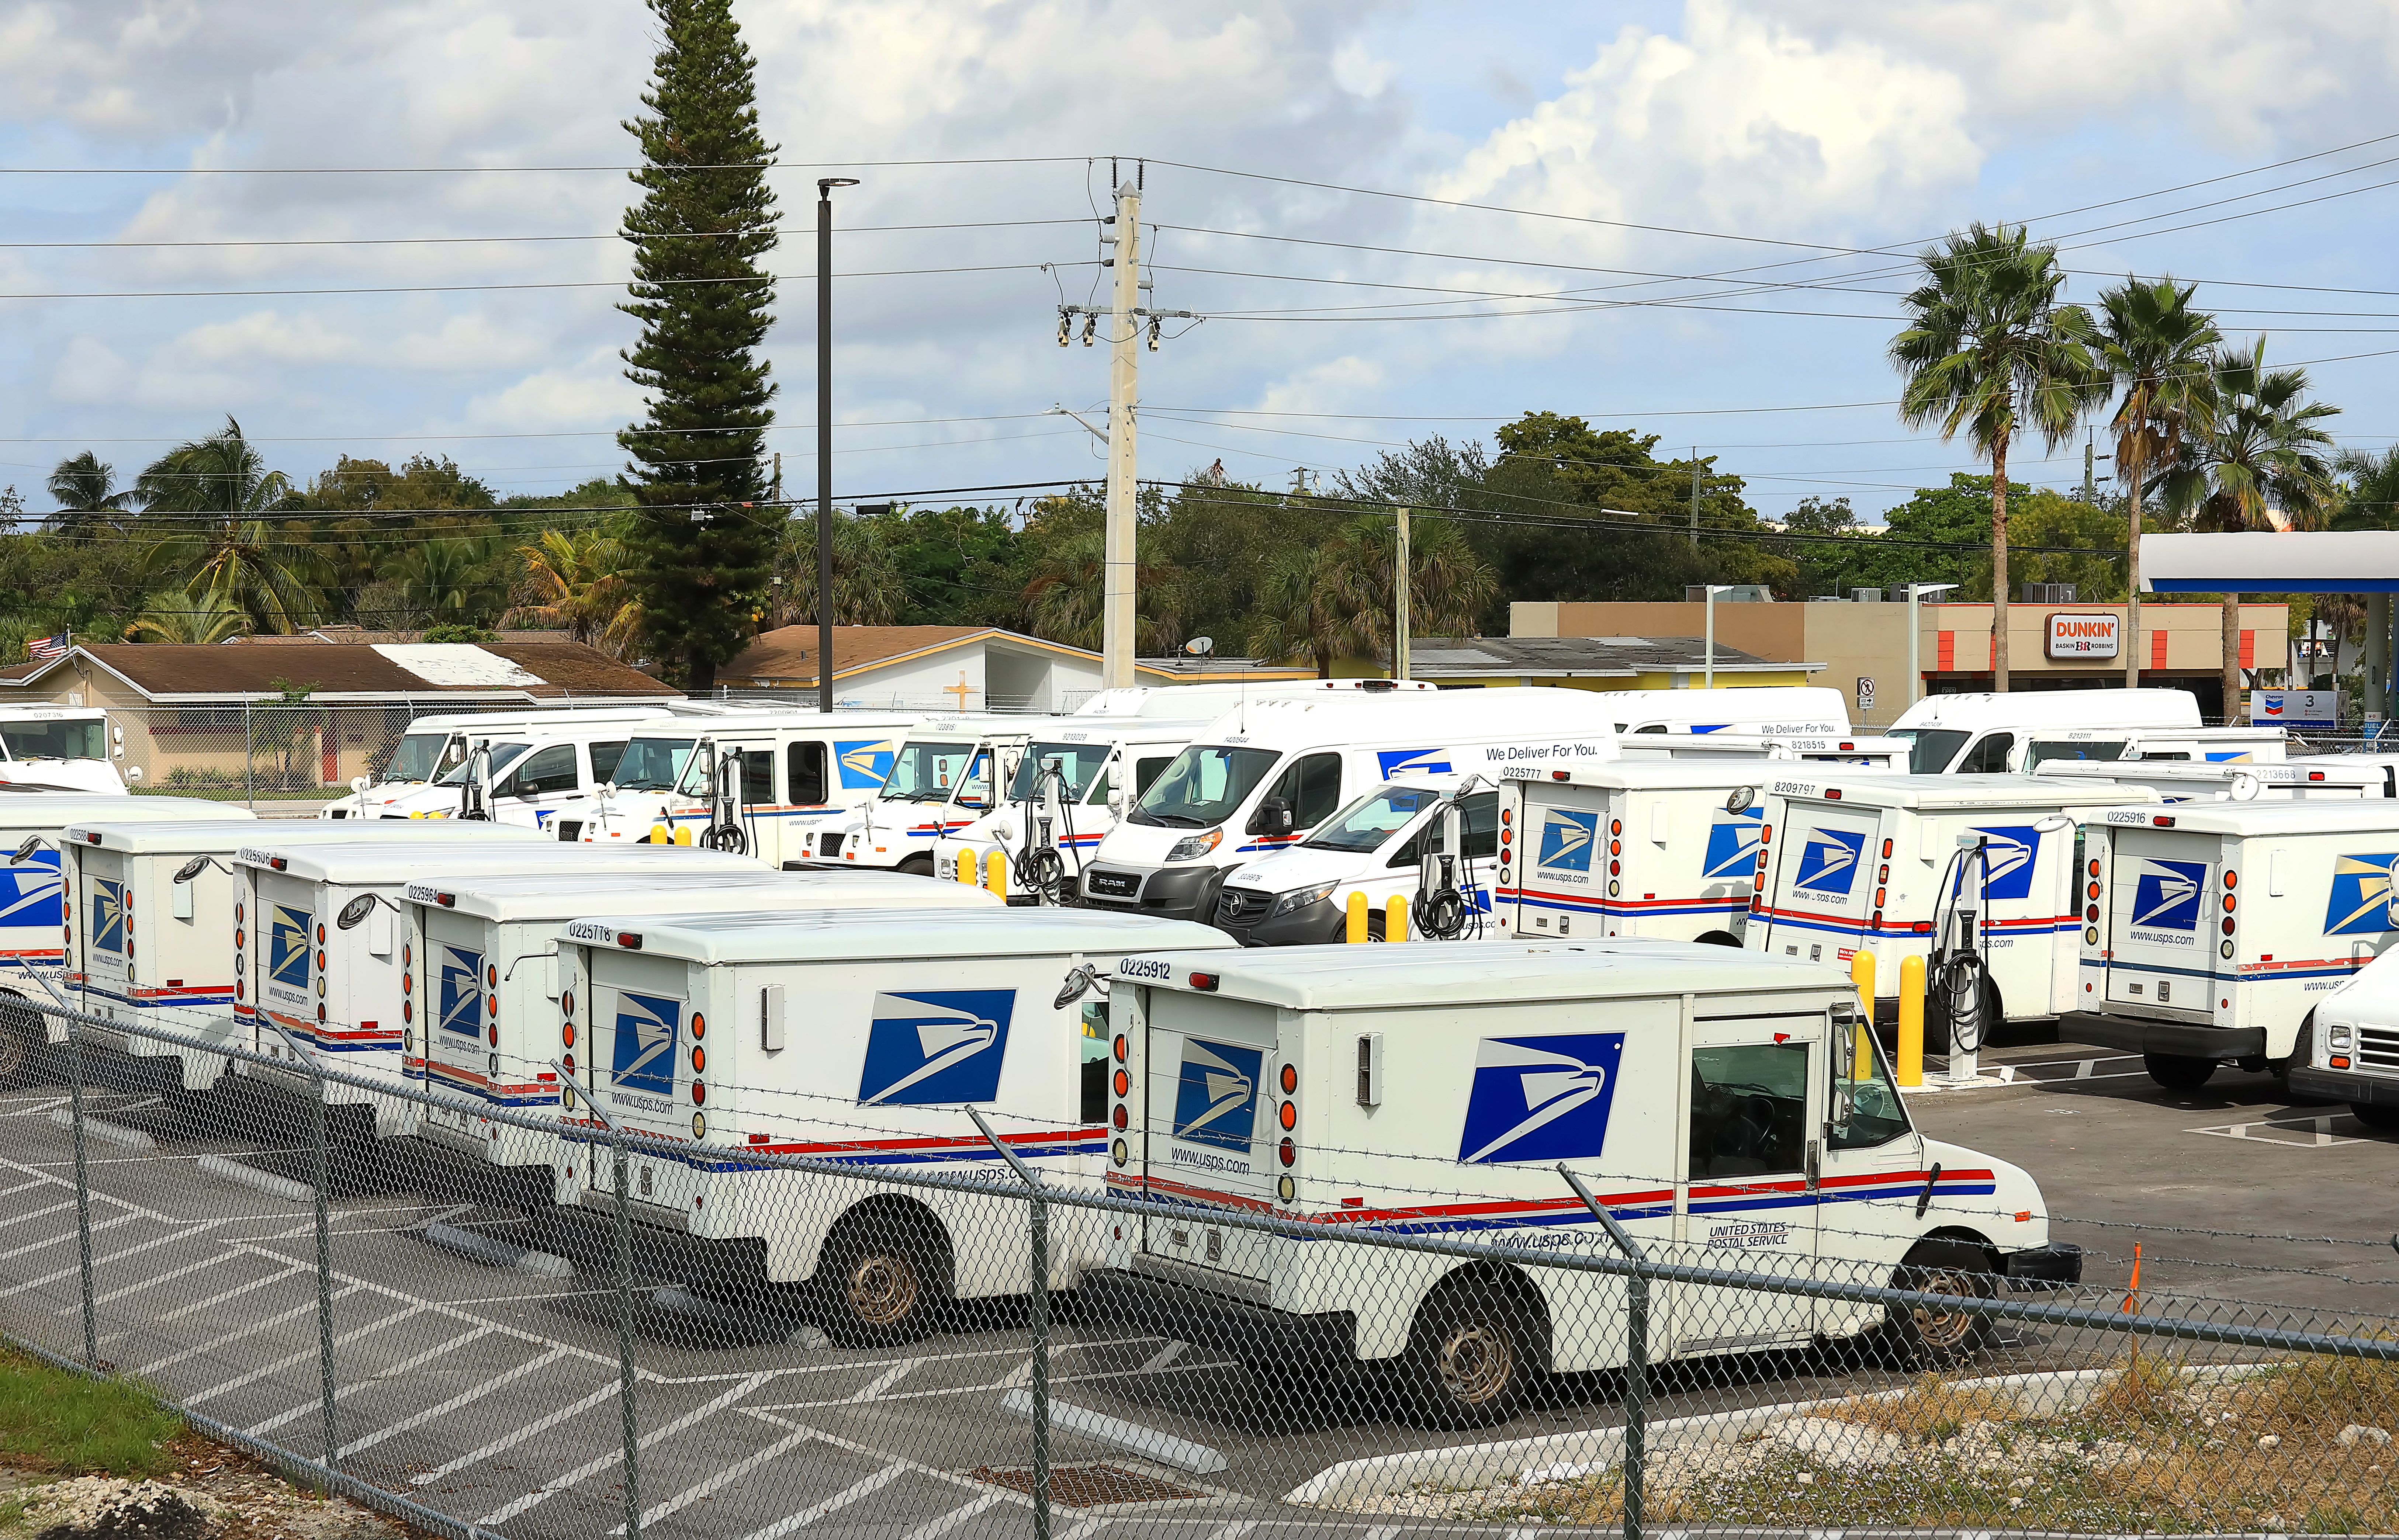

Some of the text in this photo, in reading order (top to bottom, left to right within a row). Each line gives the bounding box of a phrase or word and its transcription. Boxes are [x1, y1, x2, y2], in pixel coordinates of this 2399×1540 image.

[2056, 622, 2114, 637] DUNKIN'
[2075, 641, 2091, 651] BR
[2305, 695, 2314, 707] 3
[1762, 724, 1835, 734] We Deliver For You.
[1487, 744, 1597, 760] We Deliver For You.
[1792, 741, 1825, 749] 8218515
[1503, 767, 1541, 779] 0225777
[2257, 770, 2295, 779] 2213668
[1775, 782, 1815, 795] 8209797
[2108, 811, 2146, 823] 0225916
[1099, 879, 1125, 887] RAM
[1537, 870, 1589, 885] www.usps.com
[409, 885, 437, 903] 0225964
[570, 922, 610, 941] 0225778
[2130, 930, 2194, 946] www.usps.com
[92, 953, 123, 968] www.usps.com
[1121, 958, 1170, 979] 0225912
[269, 986, 308, 1006] www.usps.com
[439, 1034, 480, 1055] www.usps.com
[612, 1093, 673, 1115] www.usps.com
[1171, 1147, 1250, 1176] www.usps.com
[1710, 1222, 1786, 1237] UNITED STATES
[1707, 1234, 1789, 1249] POSTAL SERVICE
